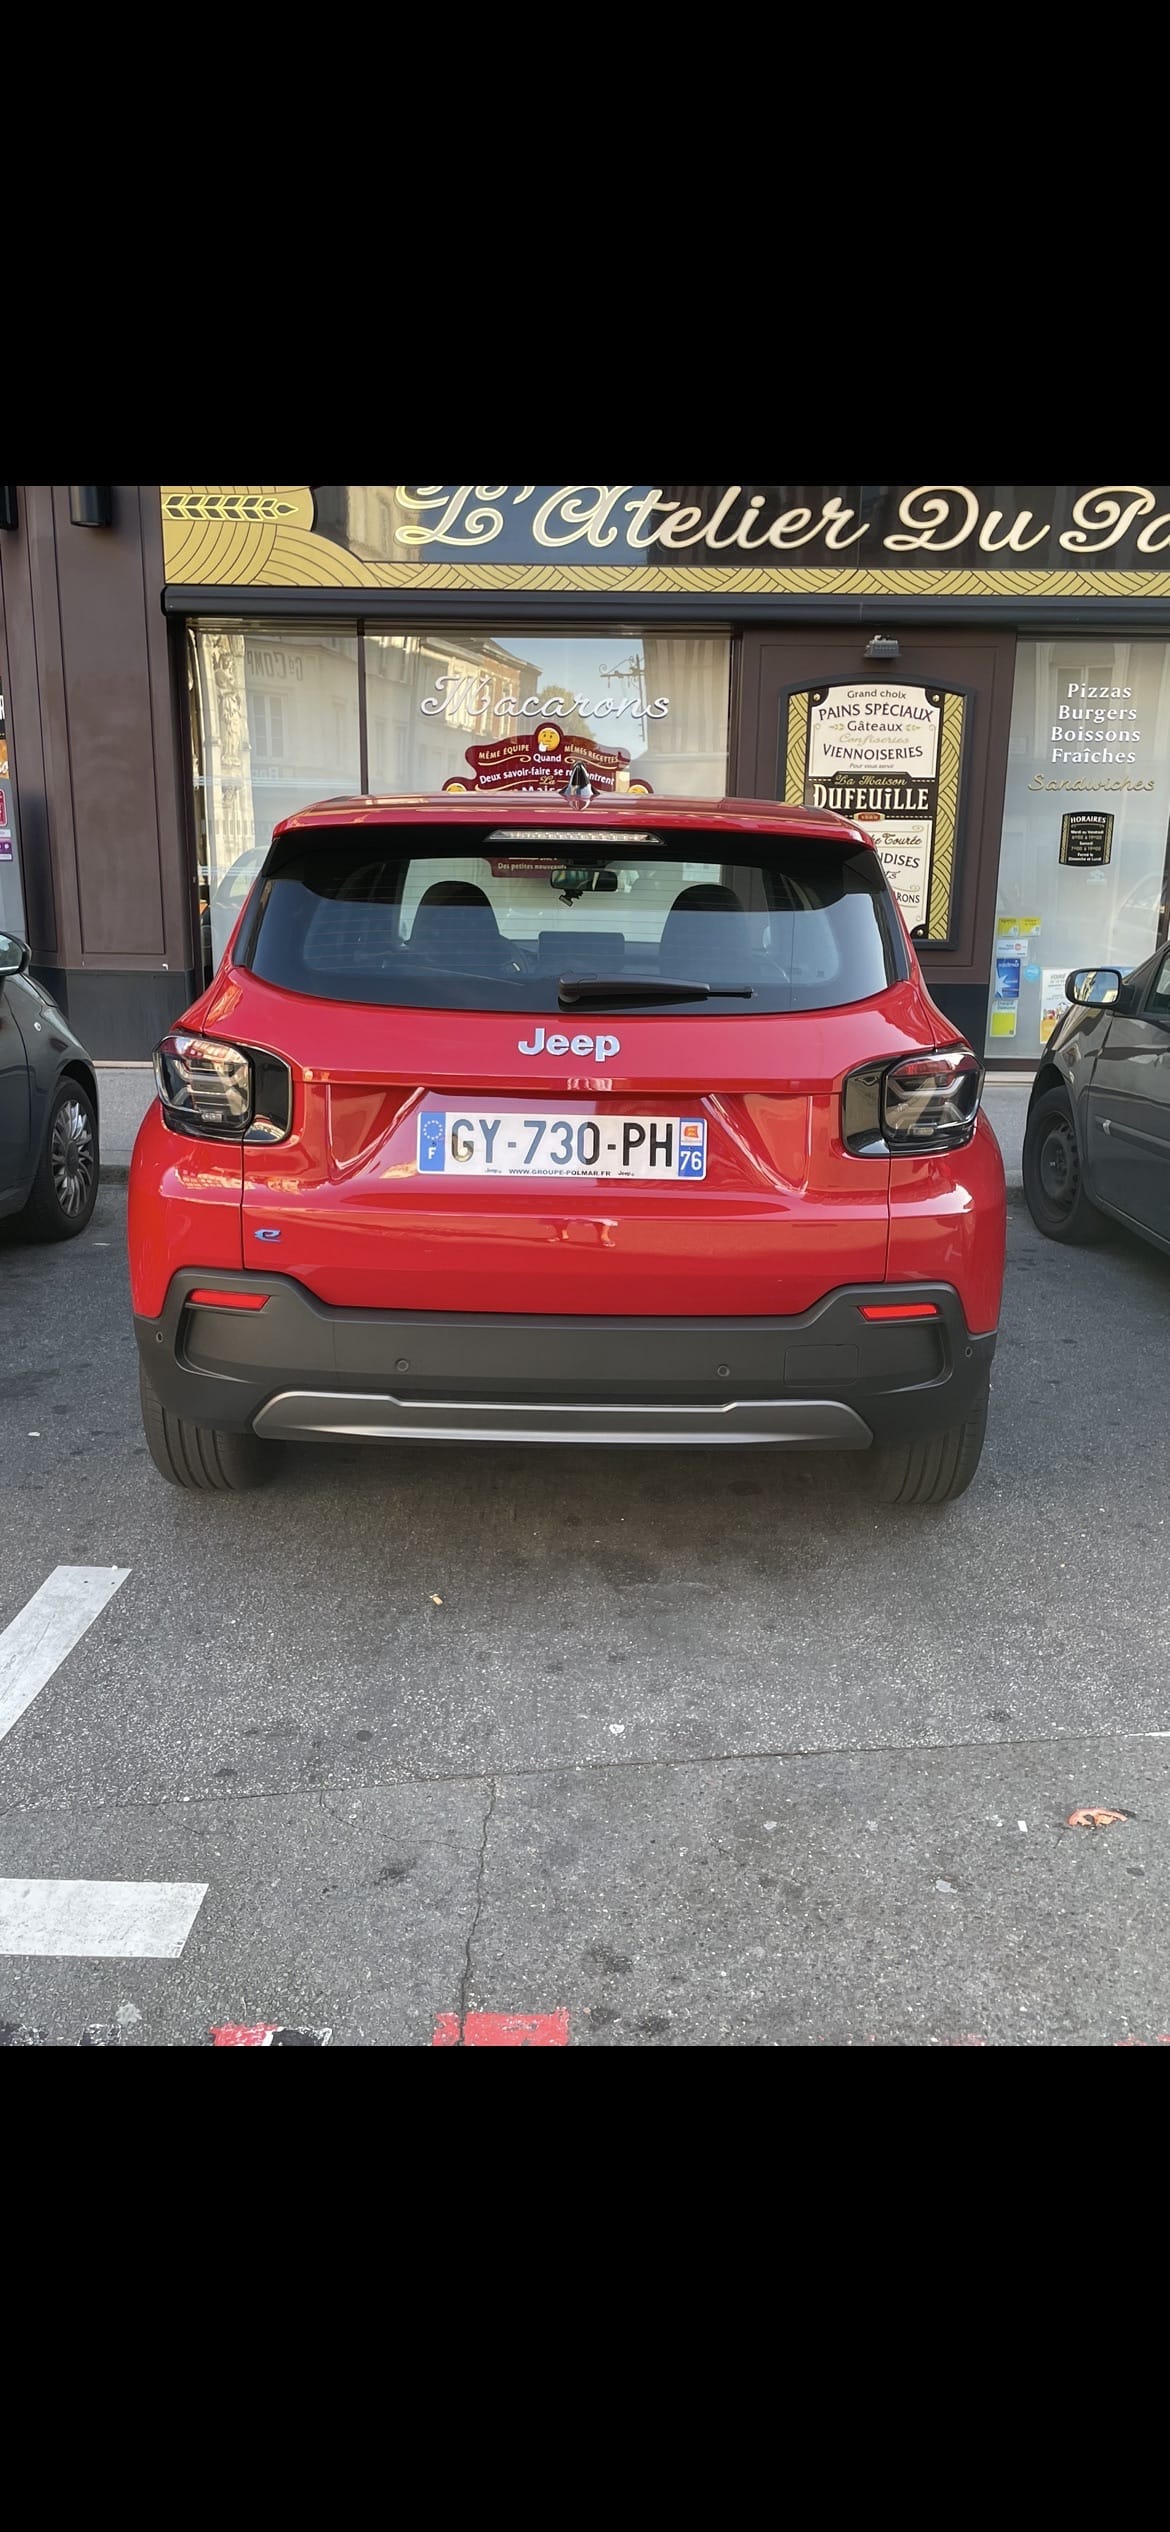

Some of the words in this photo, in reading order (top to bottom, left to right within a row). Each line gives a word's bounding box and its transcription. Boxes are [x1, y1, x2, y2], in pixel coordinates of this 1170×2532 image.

[394, 486, 870, 550] L'Atelier
[883, 486, 1051, 552] Du
[420, 674, 670, 719] Macarons
[847, 690, 877, 699] Grand
[879, 689, 907, 700] choix
[1067, 683, 1132, 699] Pizzas
[819, 703, 861, 721] PAINS
[865, 702, 935, 723] SPÉCIAUX
[1058, 704, 1137, 724] Burgers
[847, 720, 903, 732] Gâteaux
[1051, 726, 1141, 742] Boissons
[533, 753, 562, 764] Quand
[588, 749, 619, 763] RECETTES
[823, 744, 924, 760] VIENNOISERIES
[1051, 748, 1136, 763] Fraîches
[479, 772, 502, 785] Deux
[503, 767, 551, 780] savoir-faire
[554, 768, 564, 776] se
[834, 774, 856, 785] La
[858, 774, 908, 786] Maison
[1027, 772, 1155, 792] Sandwiches
[1070, 815, 1106, 823] HORAIRES
[881, 852, 920, 868] DISES
[896, 892, 920, 904] RONS
[518, 1028, 621, 1063] Jeep
[451, 1118, 673, 1168] GY-730-PH
[428, 1146, 436, 1160] F
[679, 1150, 702, 1172] 76
[508, 1168, 612, 1177] WWW.GROUPE-POLMAR.FR
